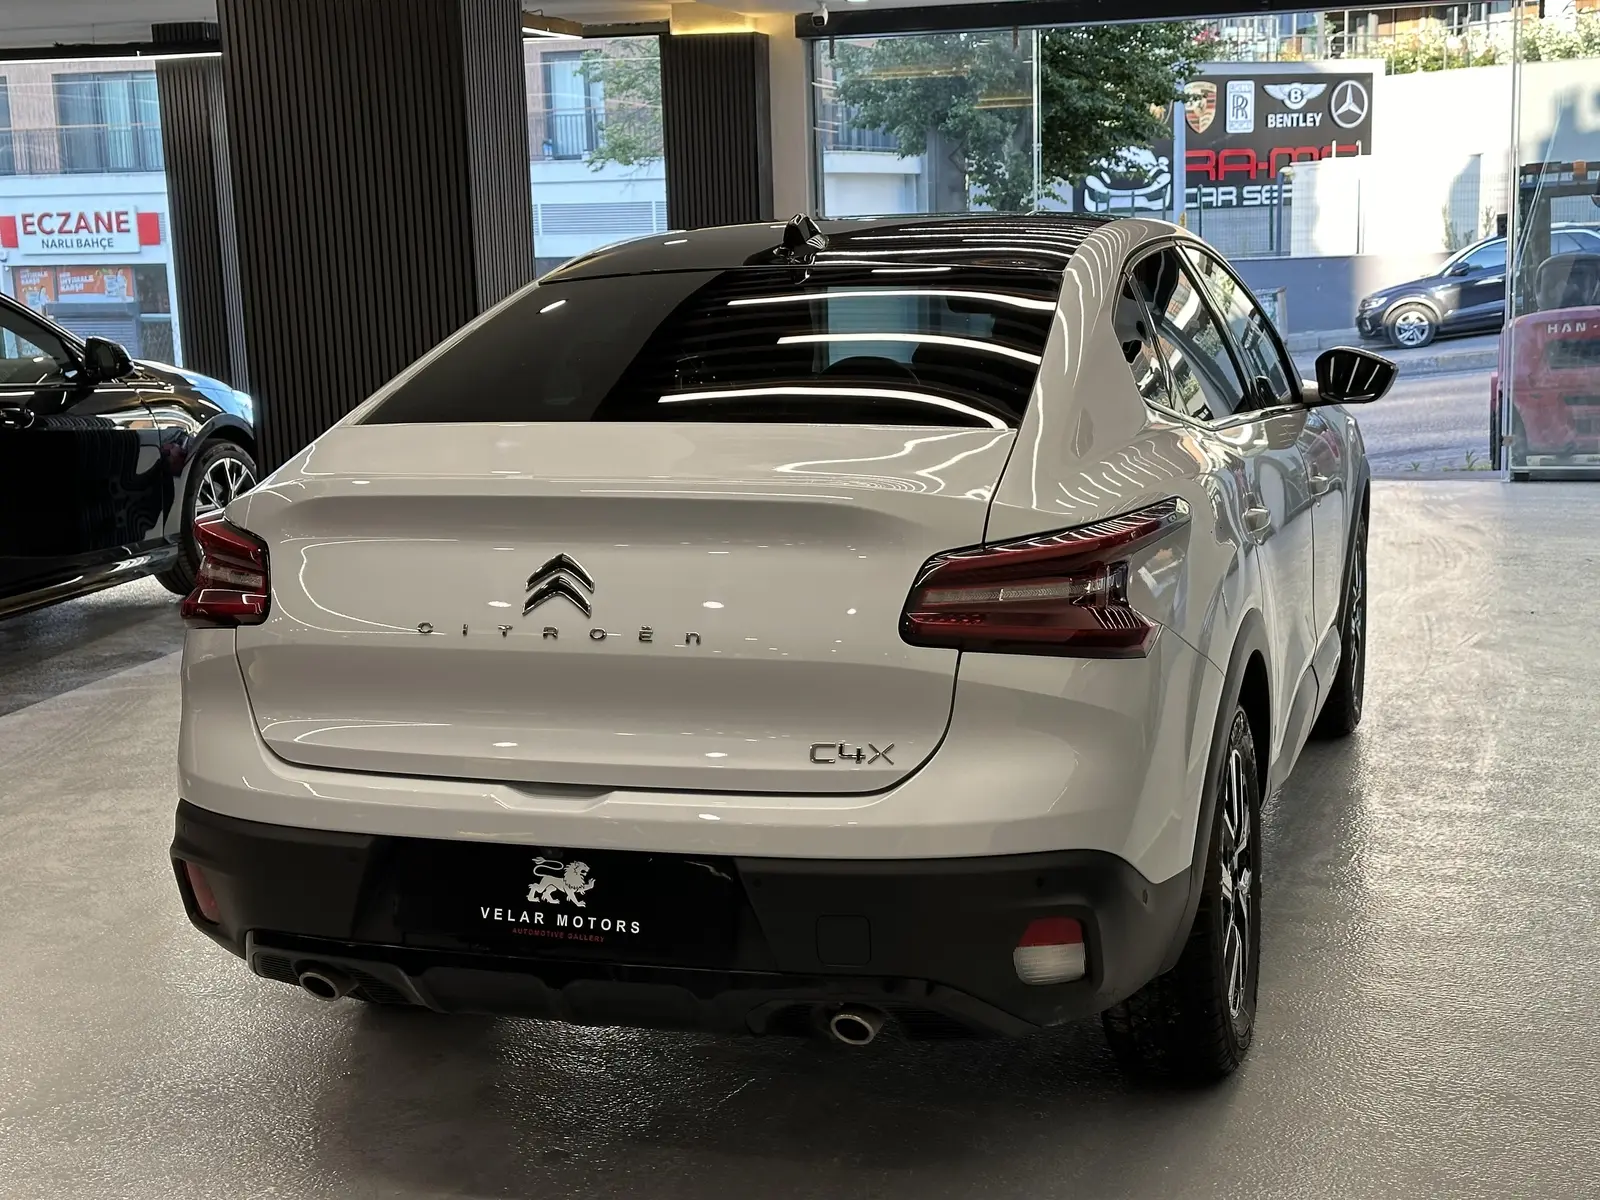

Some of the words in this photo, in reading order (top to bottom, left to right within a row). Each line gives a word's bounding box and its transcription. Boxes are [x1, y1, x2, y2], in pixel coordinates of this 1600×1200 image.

[1267, 113, 1323, 128] BENTLEY
[21, 211, 131, 235] ECZANE
[41, 238, 74, 249] NARLI
[76, 237, 114, 250] BAHÇE
[480, 906, 545, 925] VELAR
[556, 913, 641, 934] MOTORS
[511, 927, 564, 939] AUTOMOTIVE
[567, 933, 605, 943] GALLERY
